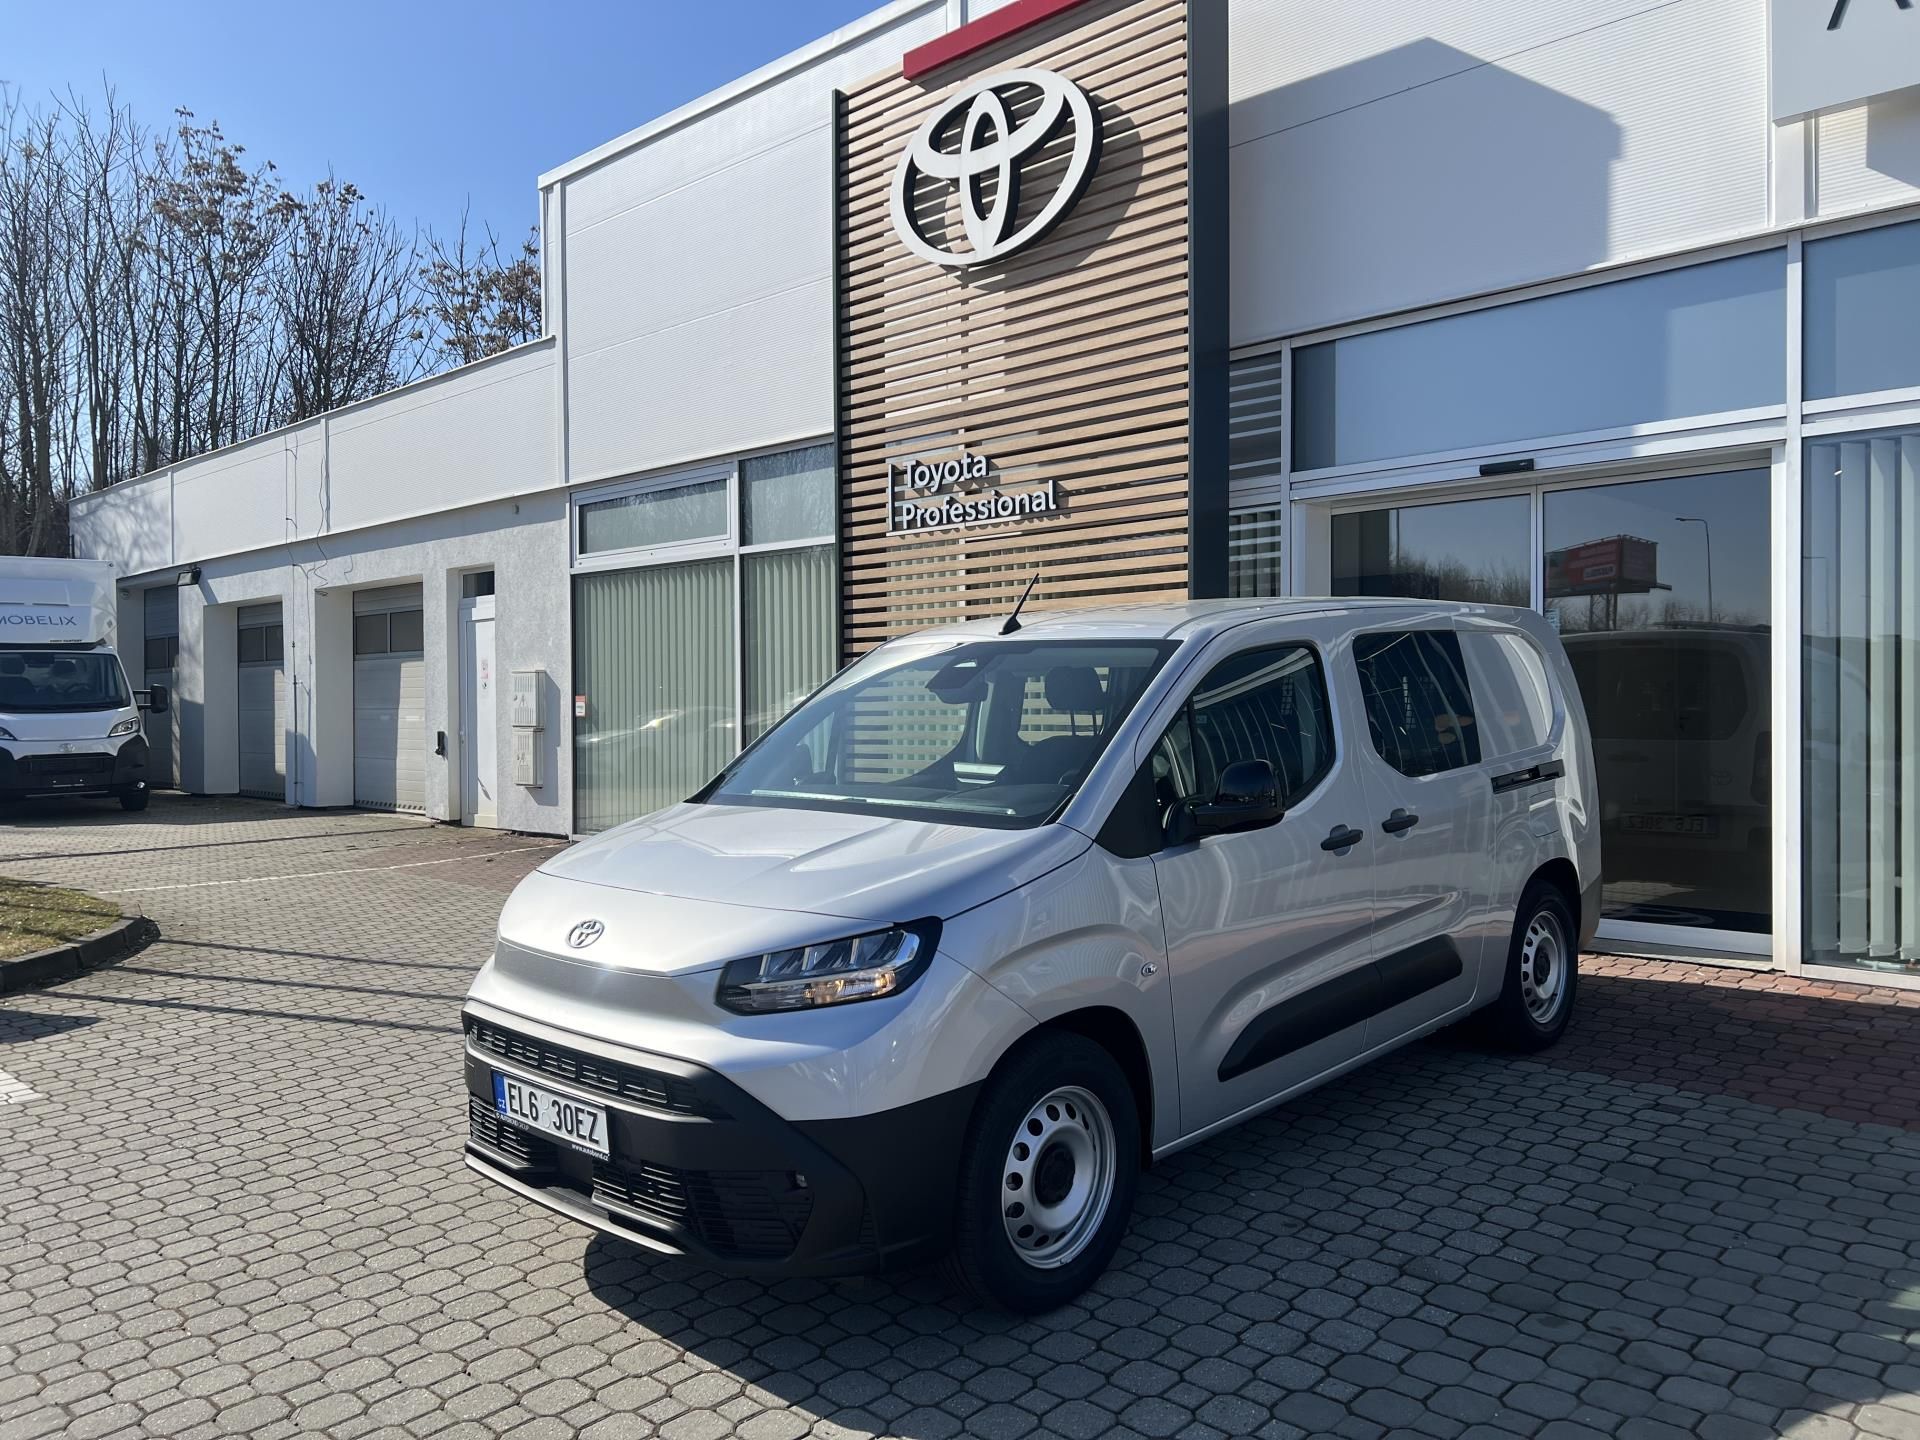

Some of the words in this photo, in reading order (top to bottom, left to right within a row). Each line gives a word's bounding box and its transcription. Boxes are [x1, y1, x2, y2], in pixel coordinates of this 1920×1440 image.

[904, 452, 988, 493] Toyota
[902, 479, 1056, 529] Professional
[498, 1099, 506, 1109] CZ
[508, 1082, 539, 1122] EL6
[551, 1100, 600, 1145] 30EZ
